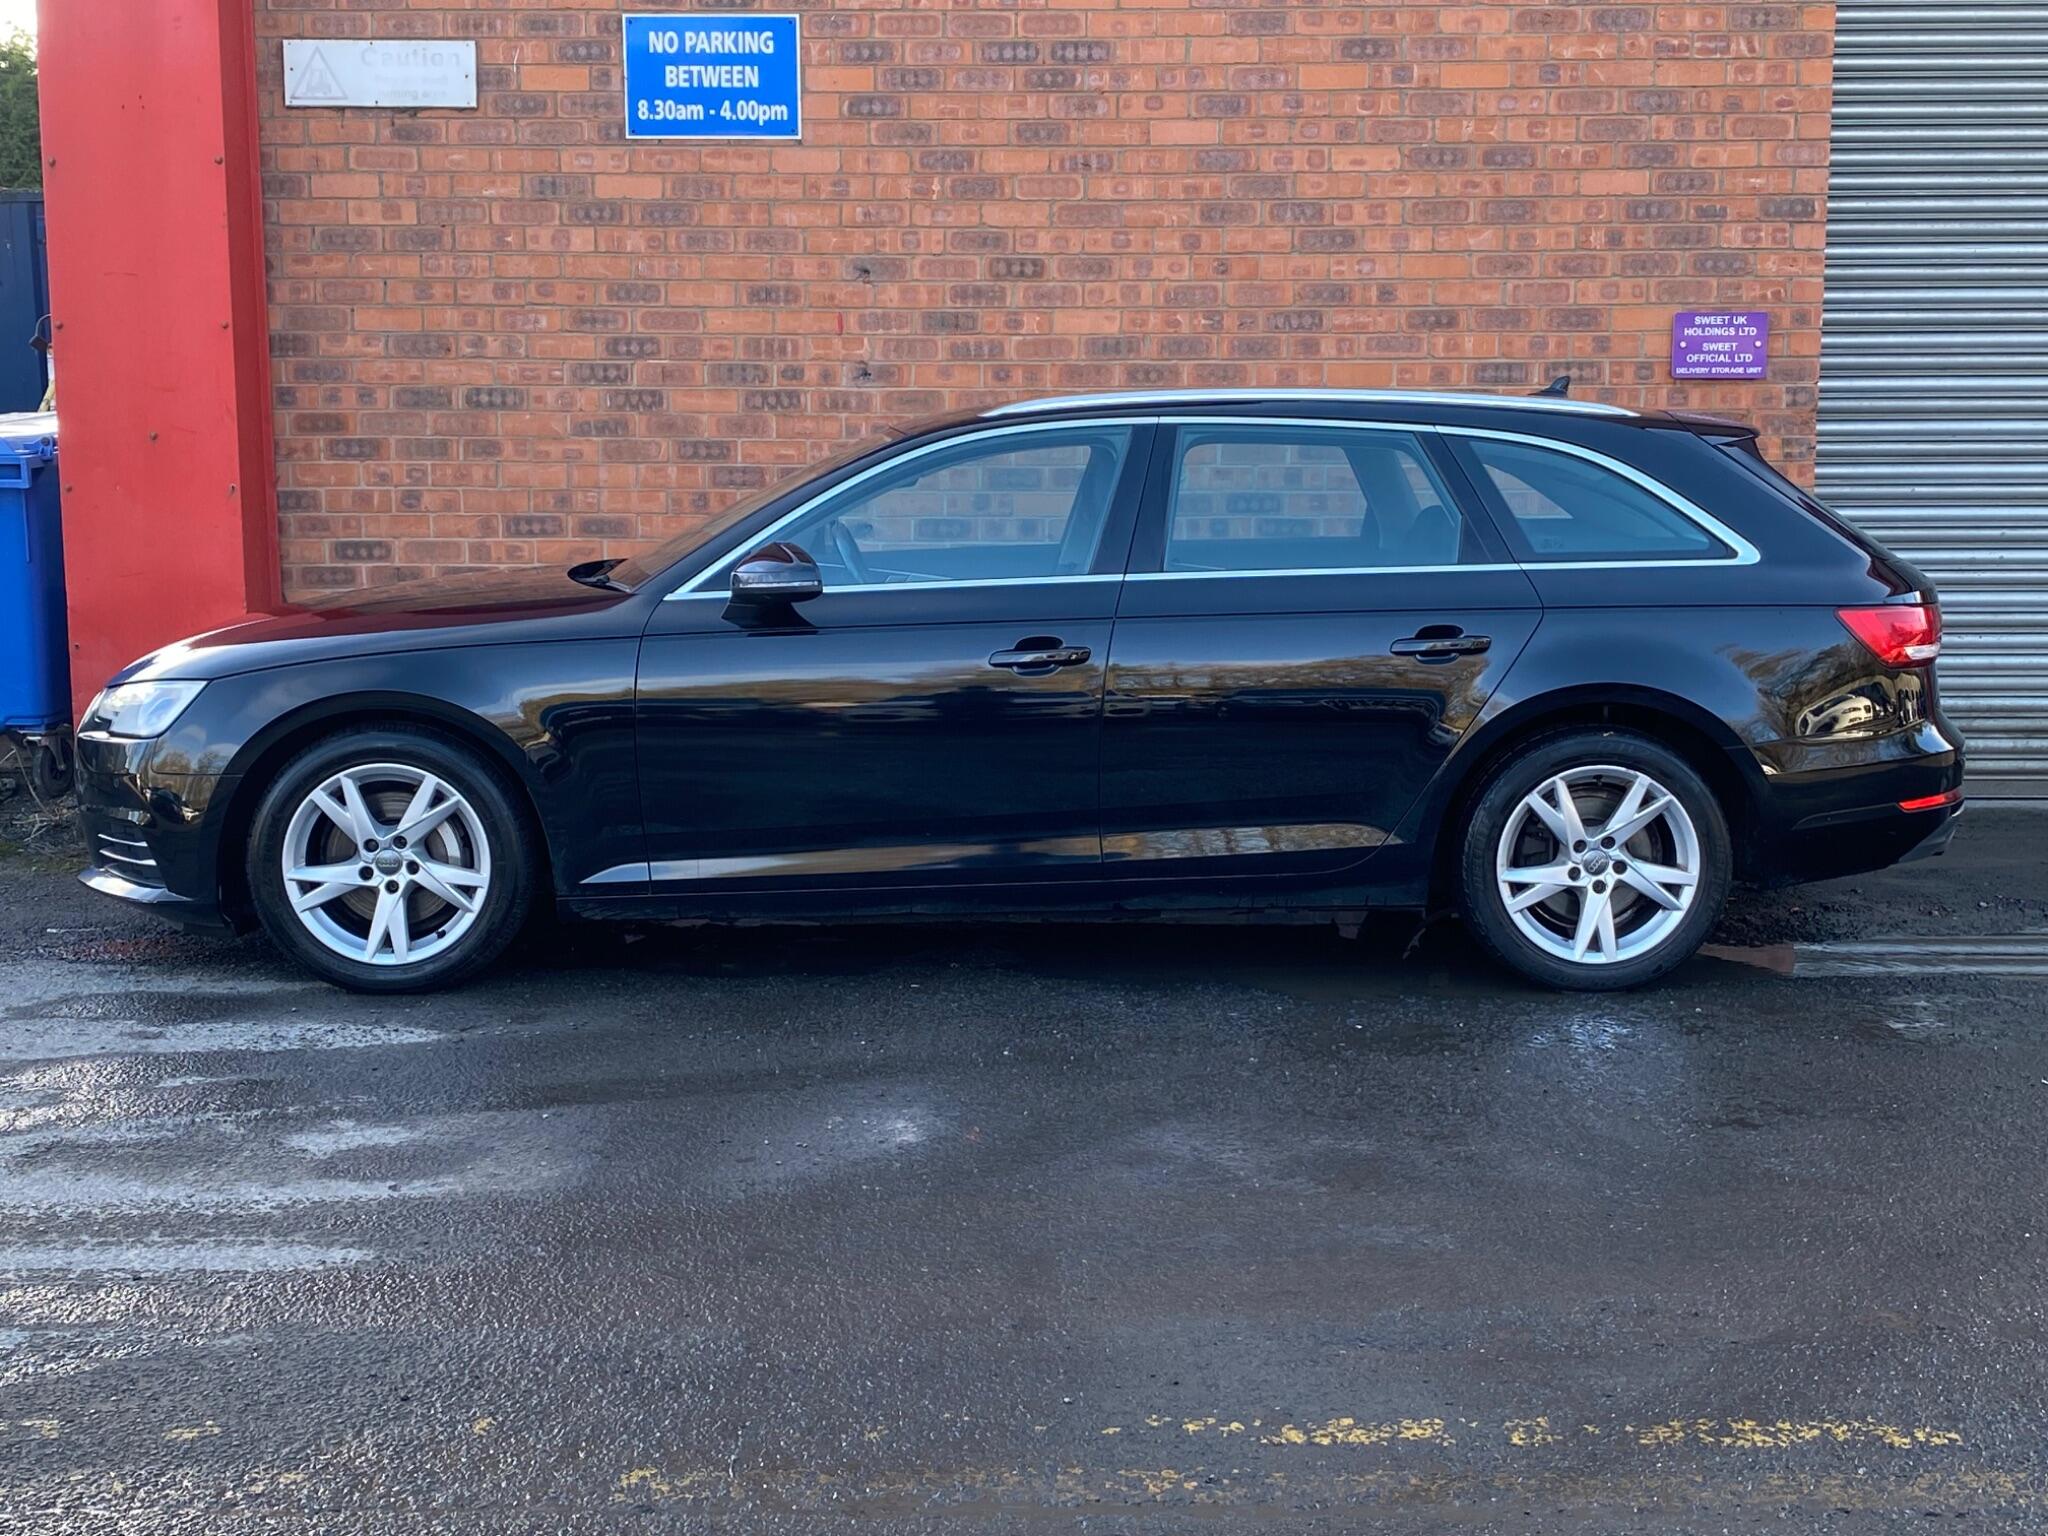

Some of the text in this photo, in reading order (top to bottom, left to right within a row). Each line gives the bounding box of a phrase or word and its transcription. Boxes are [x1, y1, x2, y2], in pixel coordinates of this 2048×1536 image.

[648, 31, 774, 54] NO PARKING
[360, 47, 460, 67] Caution
[665, 65, 759, 88] BETWEEN
[637, 99, 704, 121] 8.30am
[720, 99, 788, 126] 4.00pm
[1694, 315, 1747, 325] SWEET UK
[1684, 327, 1757, 336] HOLDINGS LTD
[1702, 342, 1738, 352] SWEET
[1686, 354, 1753, 363] OFFICIAL LTD
